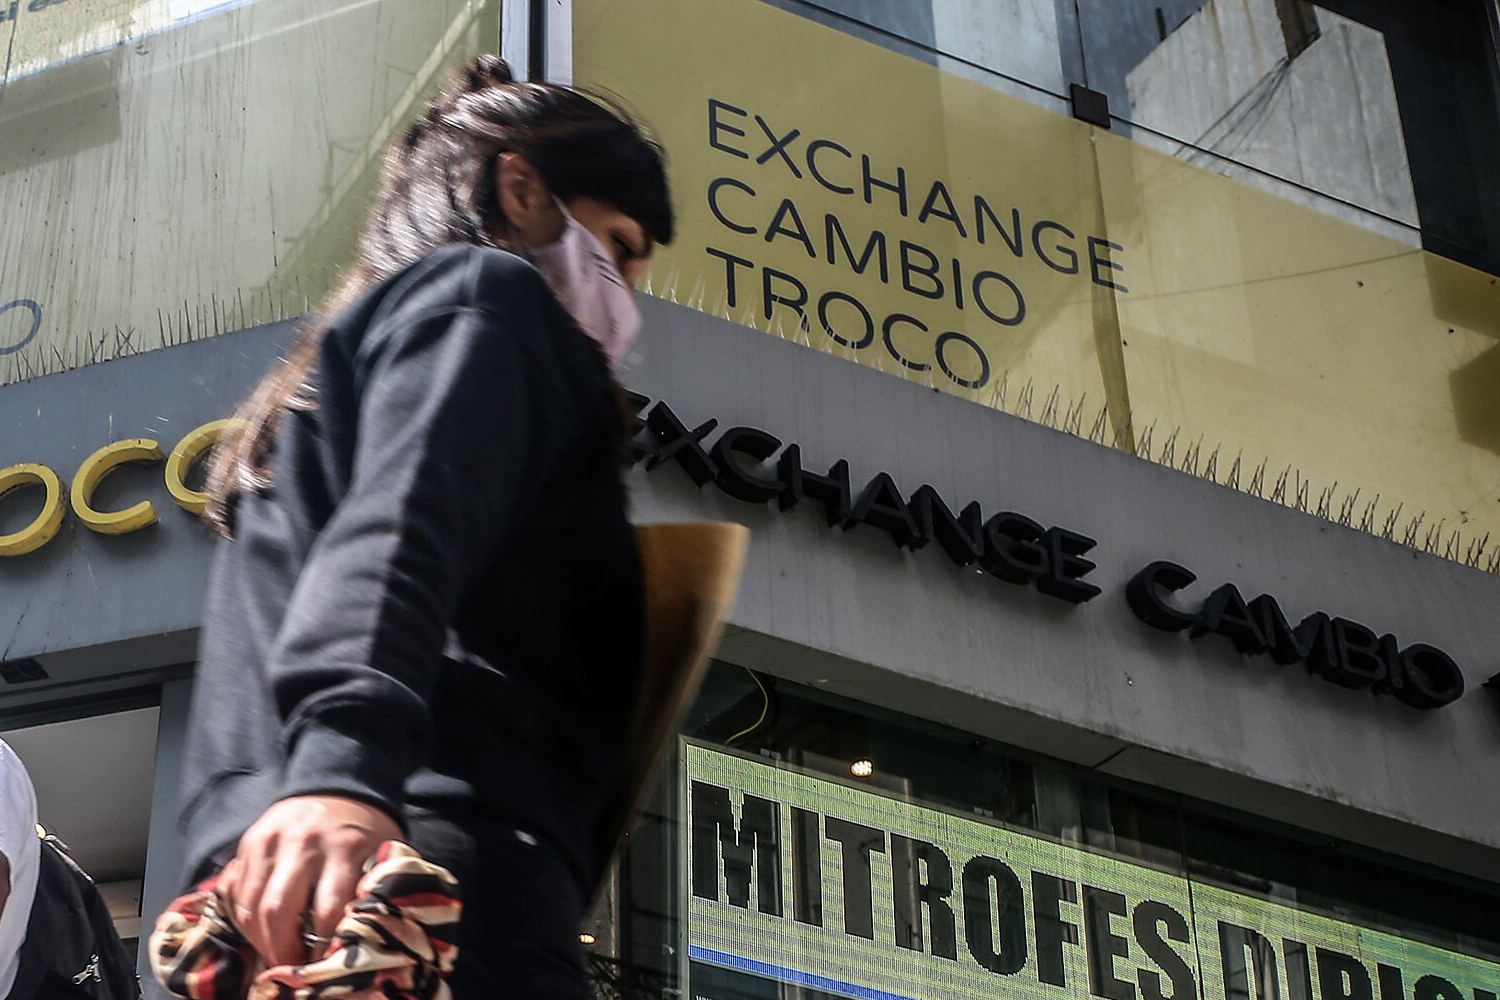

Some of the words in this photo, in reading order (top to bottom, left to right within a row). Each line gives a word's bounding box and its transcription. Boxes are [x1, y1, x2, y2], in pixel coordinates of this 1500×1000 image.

[707, 177, 1026, 326] CAMBIO
[708, 98, 1129, 294] EXCHANGE
[706, 247, 990, 389] TROCO
[1125, 560, 1466, 710] CAMBIO
